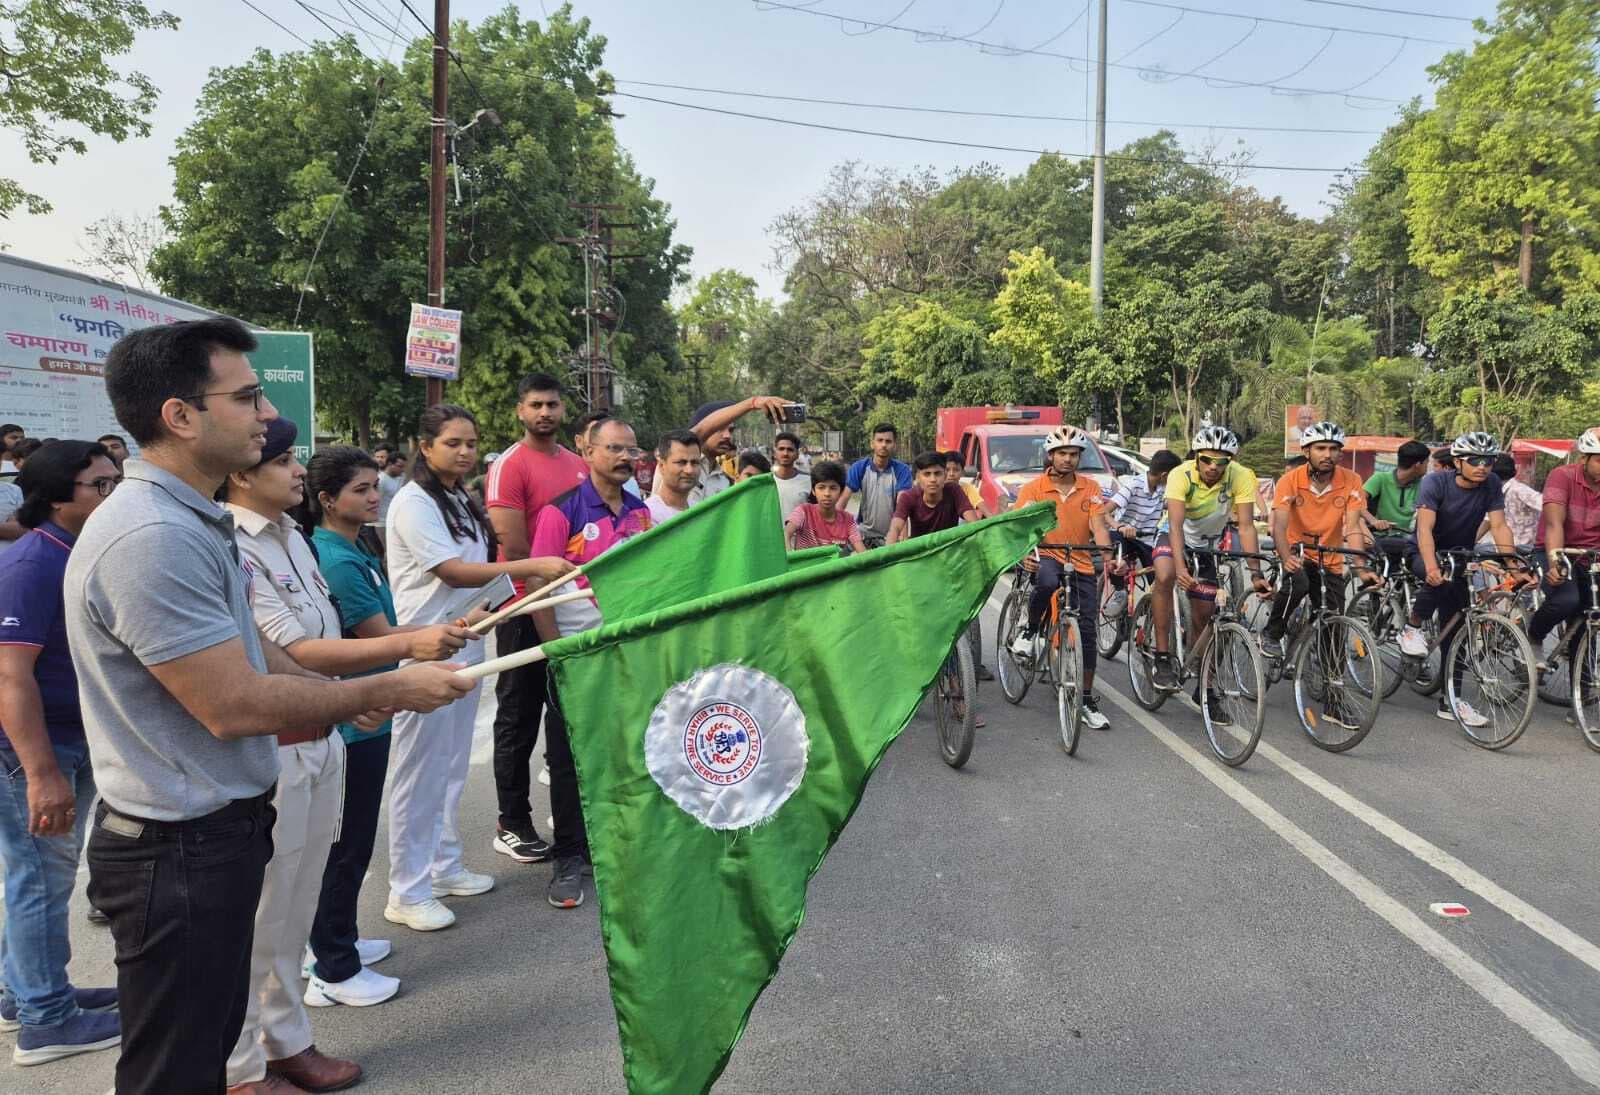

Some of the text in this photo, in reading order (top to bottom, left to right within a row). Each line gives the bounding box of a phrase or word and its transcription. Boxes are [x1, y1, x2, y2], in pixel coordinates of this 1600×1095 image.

[90, 294, 109, 312] श्री
[113, 299, 161, 323] नीतीश
[5, 332, 88, 356] चम्पारण
[263, 365, 305, 383] कार्यालय
[715, 705, 732, 714] WE
[687, 710, 709, 736] BIHAR
[732, 708, 757, 736] SERVE
[687, 738, 697, 760] FIRE
[750, 739, 759, 752] TO
[693, 761, 732, 783] SERVICE
[738, 754, 756, 777] SAVE
